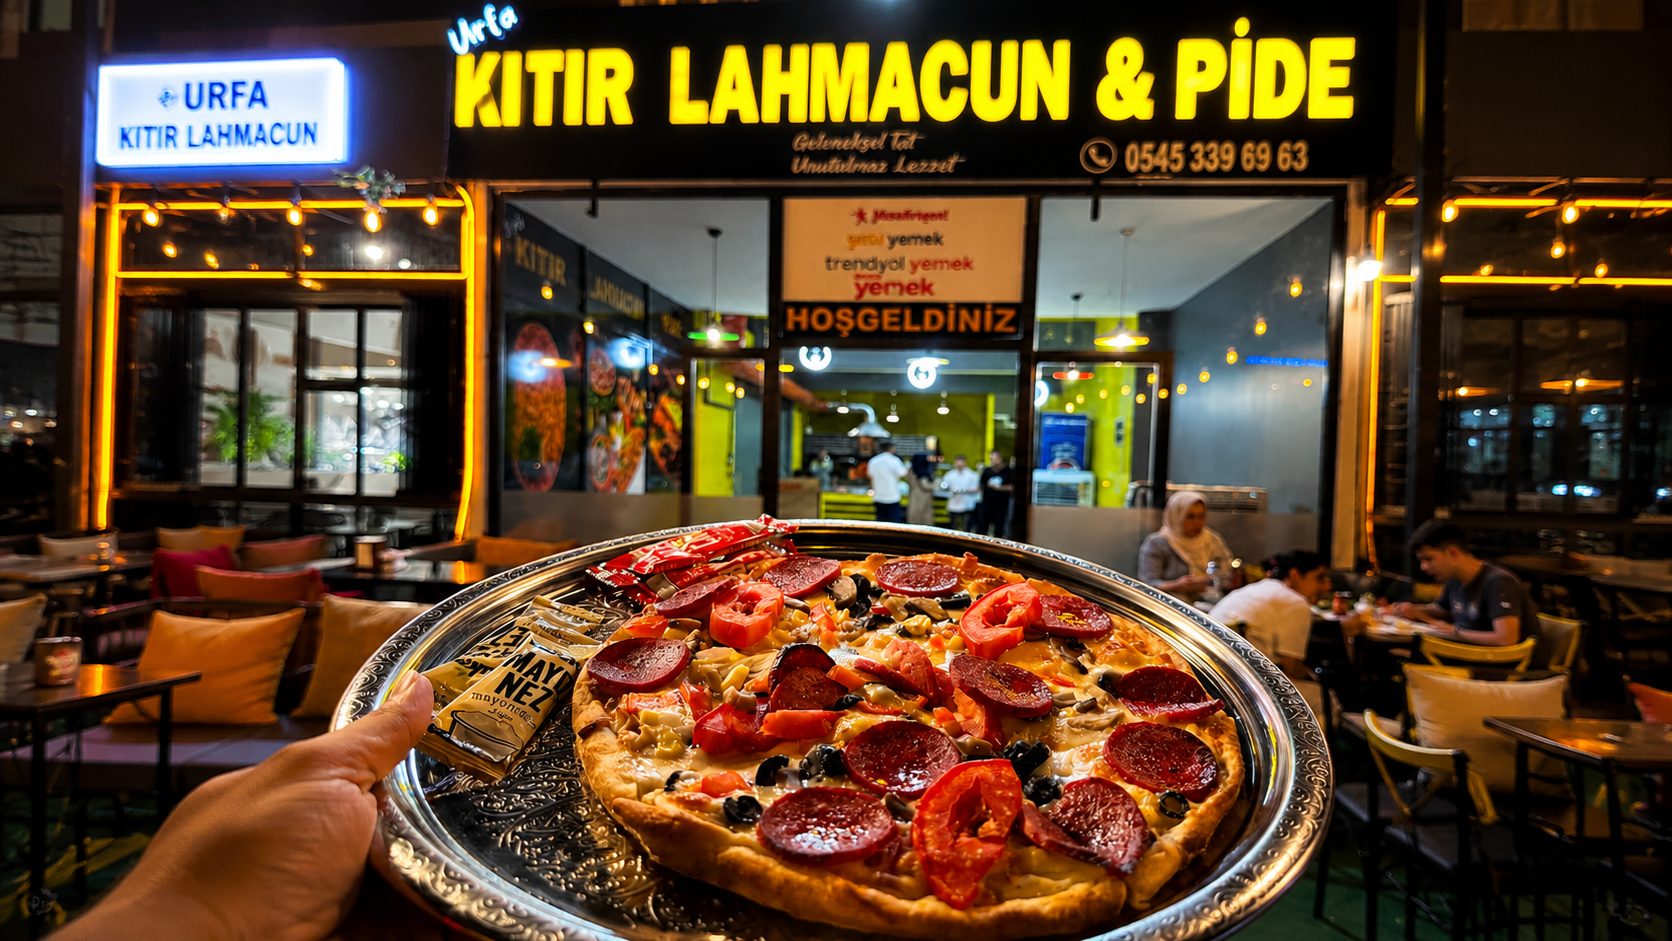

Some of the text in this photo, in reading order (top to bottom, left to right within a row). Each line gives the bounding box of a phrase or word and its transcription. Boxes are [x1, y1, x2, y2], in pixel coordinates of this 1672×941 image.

[447, 3, 519, 56] Urfa
[454, 16, 1357, 128] KITIR LAHMACUN & PİDE
[184, 81, 268, 110] URFA
[119, 121, 318, 149] KITIR LAHMACUN
[792, 129, 926, 153] Geleneksel Tat
[790, 152, 967, 174] Unutulmaz Lezzet
[1124, 139, 1310, 173] 0545 339 69 63
[887, 231, 945, 250] yemek
[825, 256, 974, 275] trendyol yemek
[854, 278, 935, 301] yemek
[785, 303, 1018, 338] HOŞGELDİNİZ
[494, 671, 554, 713] NEZ
